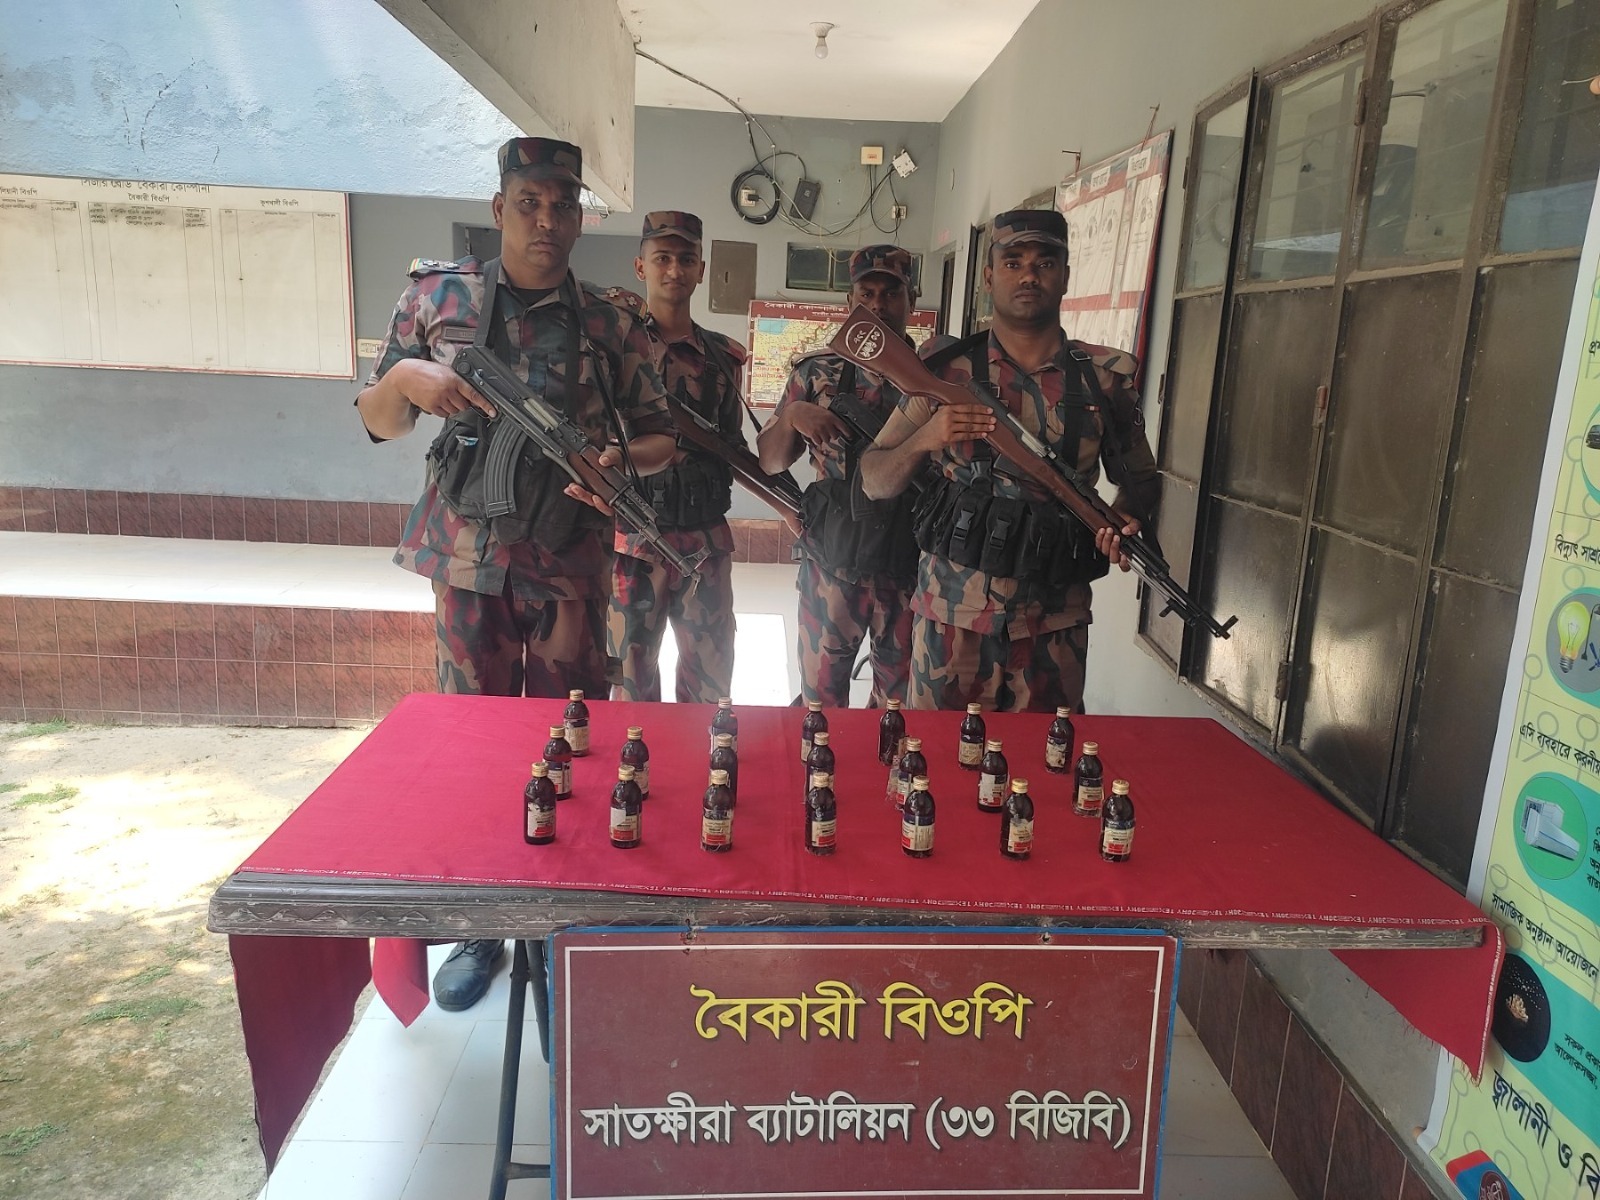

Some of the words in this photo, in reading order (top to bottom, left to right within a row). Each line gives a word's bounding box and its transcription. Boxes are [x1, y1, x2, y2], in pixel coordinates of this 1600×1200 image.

[1554, 533, 1579, 561] বিদ্যুৎ
[1520, 722, 1535, 742] এসি
[1537, 731, 1572, 760] ব্যবহারে
[1492, 893, 1524, 926] সামাজিক
[1525, 917, 1554, 950] অনুষ্ঠান
[1555, 939, 1600, 982] আয়োজনে
[690, 980, 866, 1041] বৈকারী
[877, 981, 1033, 1040] বিওপি
[579, 1091, 738, 1147] সাতক্ষীরা
[744, 1090, 916, 1142] ব্যাটালিয়ন
[925, 1096, 996, 1150] (৩৩
[1005, 1090, 1131, 1150] বিজিবি)
[1492, 1069, 1552, 1149] জ্বালানী
[1557, 1138, 1573, 1169] ও
